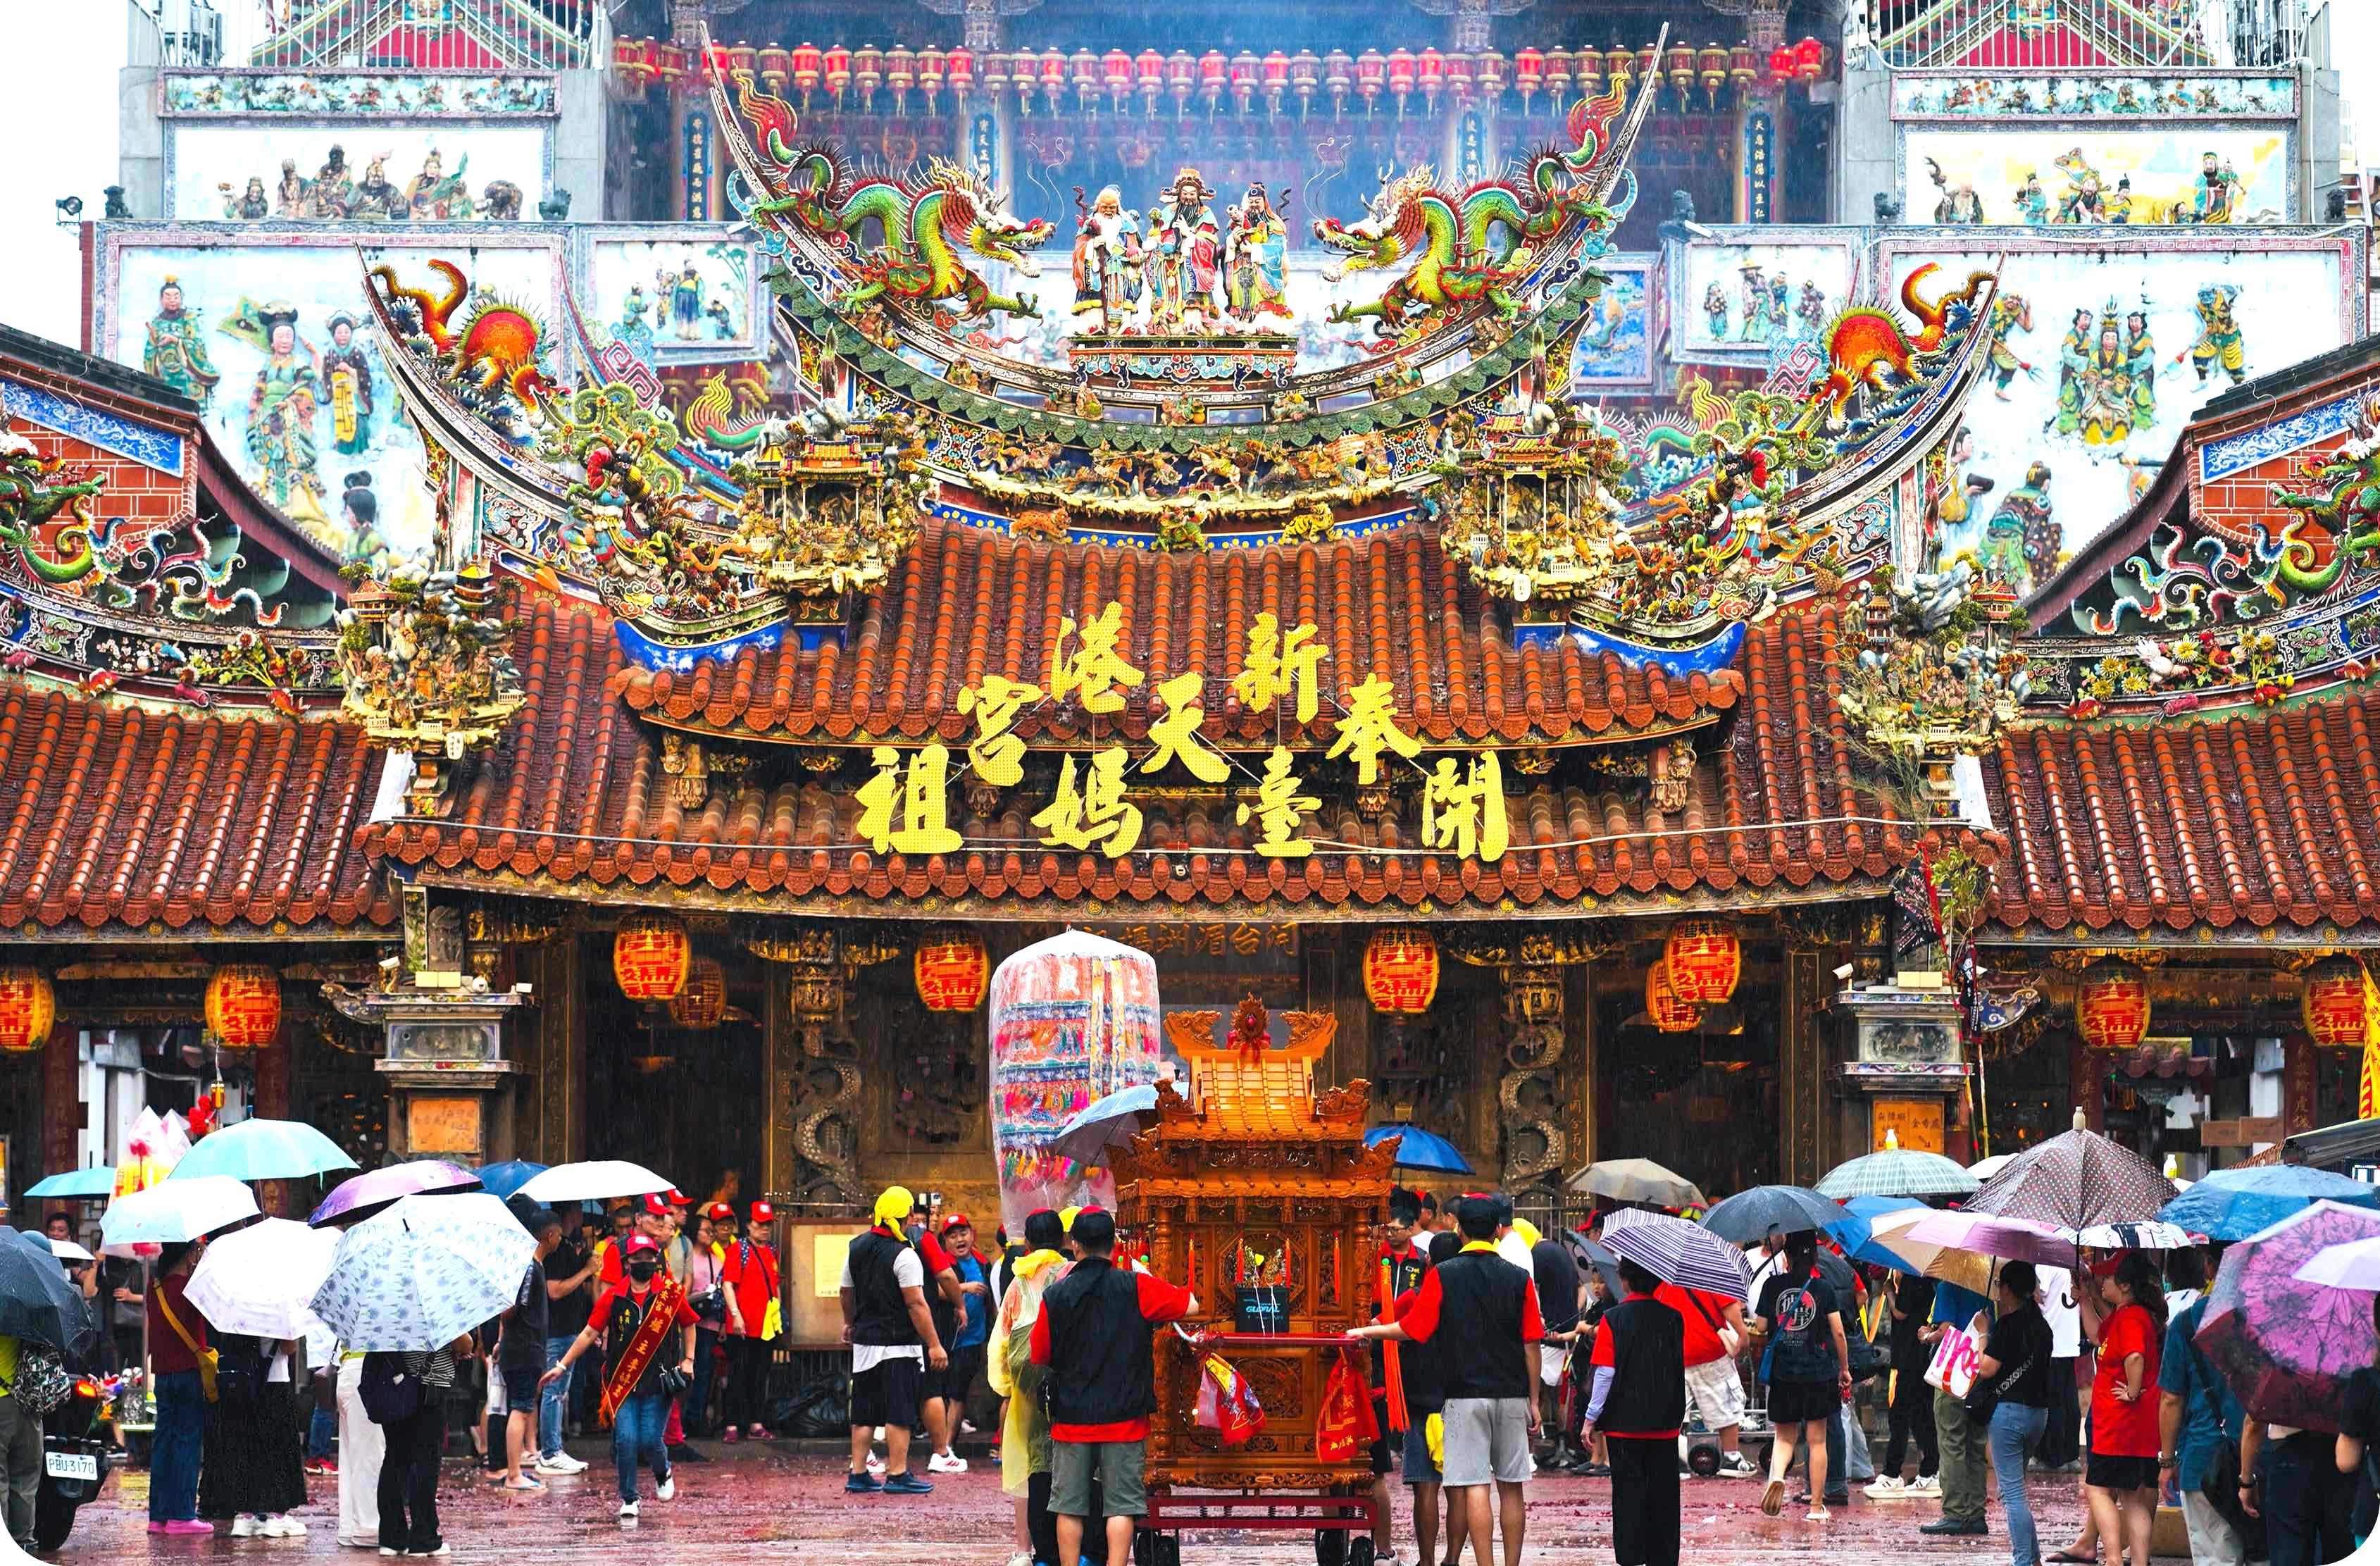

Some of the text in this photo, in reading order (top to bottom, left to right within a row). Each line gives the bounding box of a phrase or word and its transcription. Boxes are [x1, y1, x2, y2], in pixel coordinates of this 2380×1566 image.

[1049, 601, 1330, 724] 新港
[957, 671, 1422, 785] 奉天宮
[855, 740, 1509, 861] 開臺媽祖
